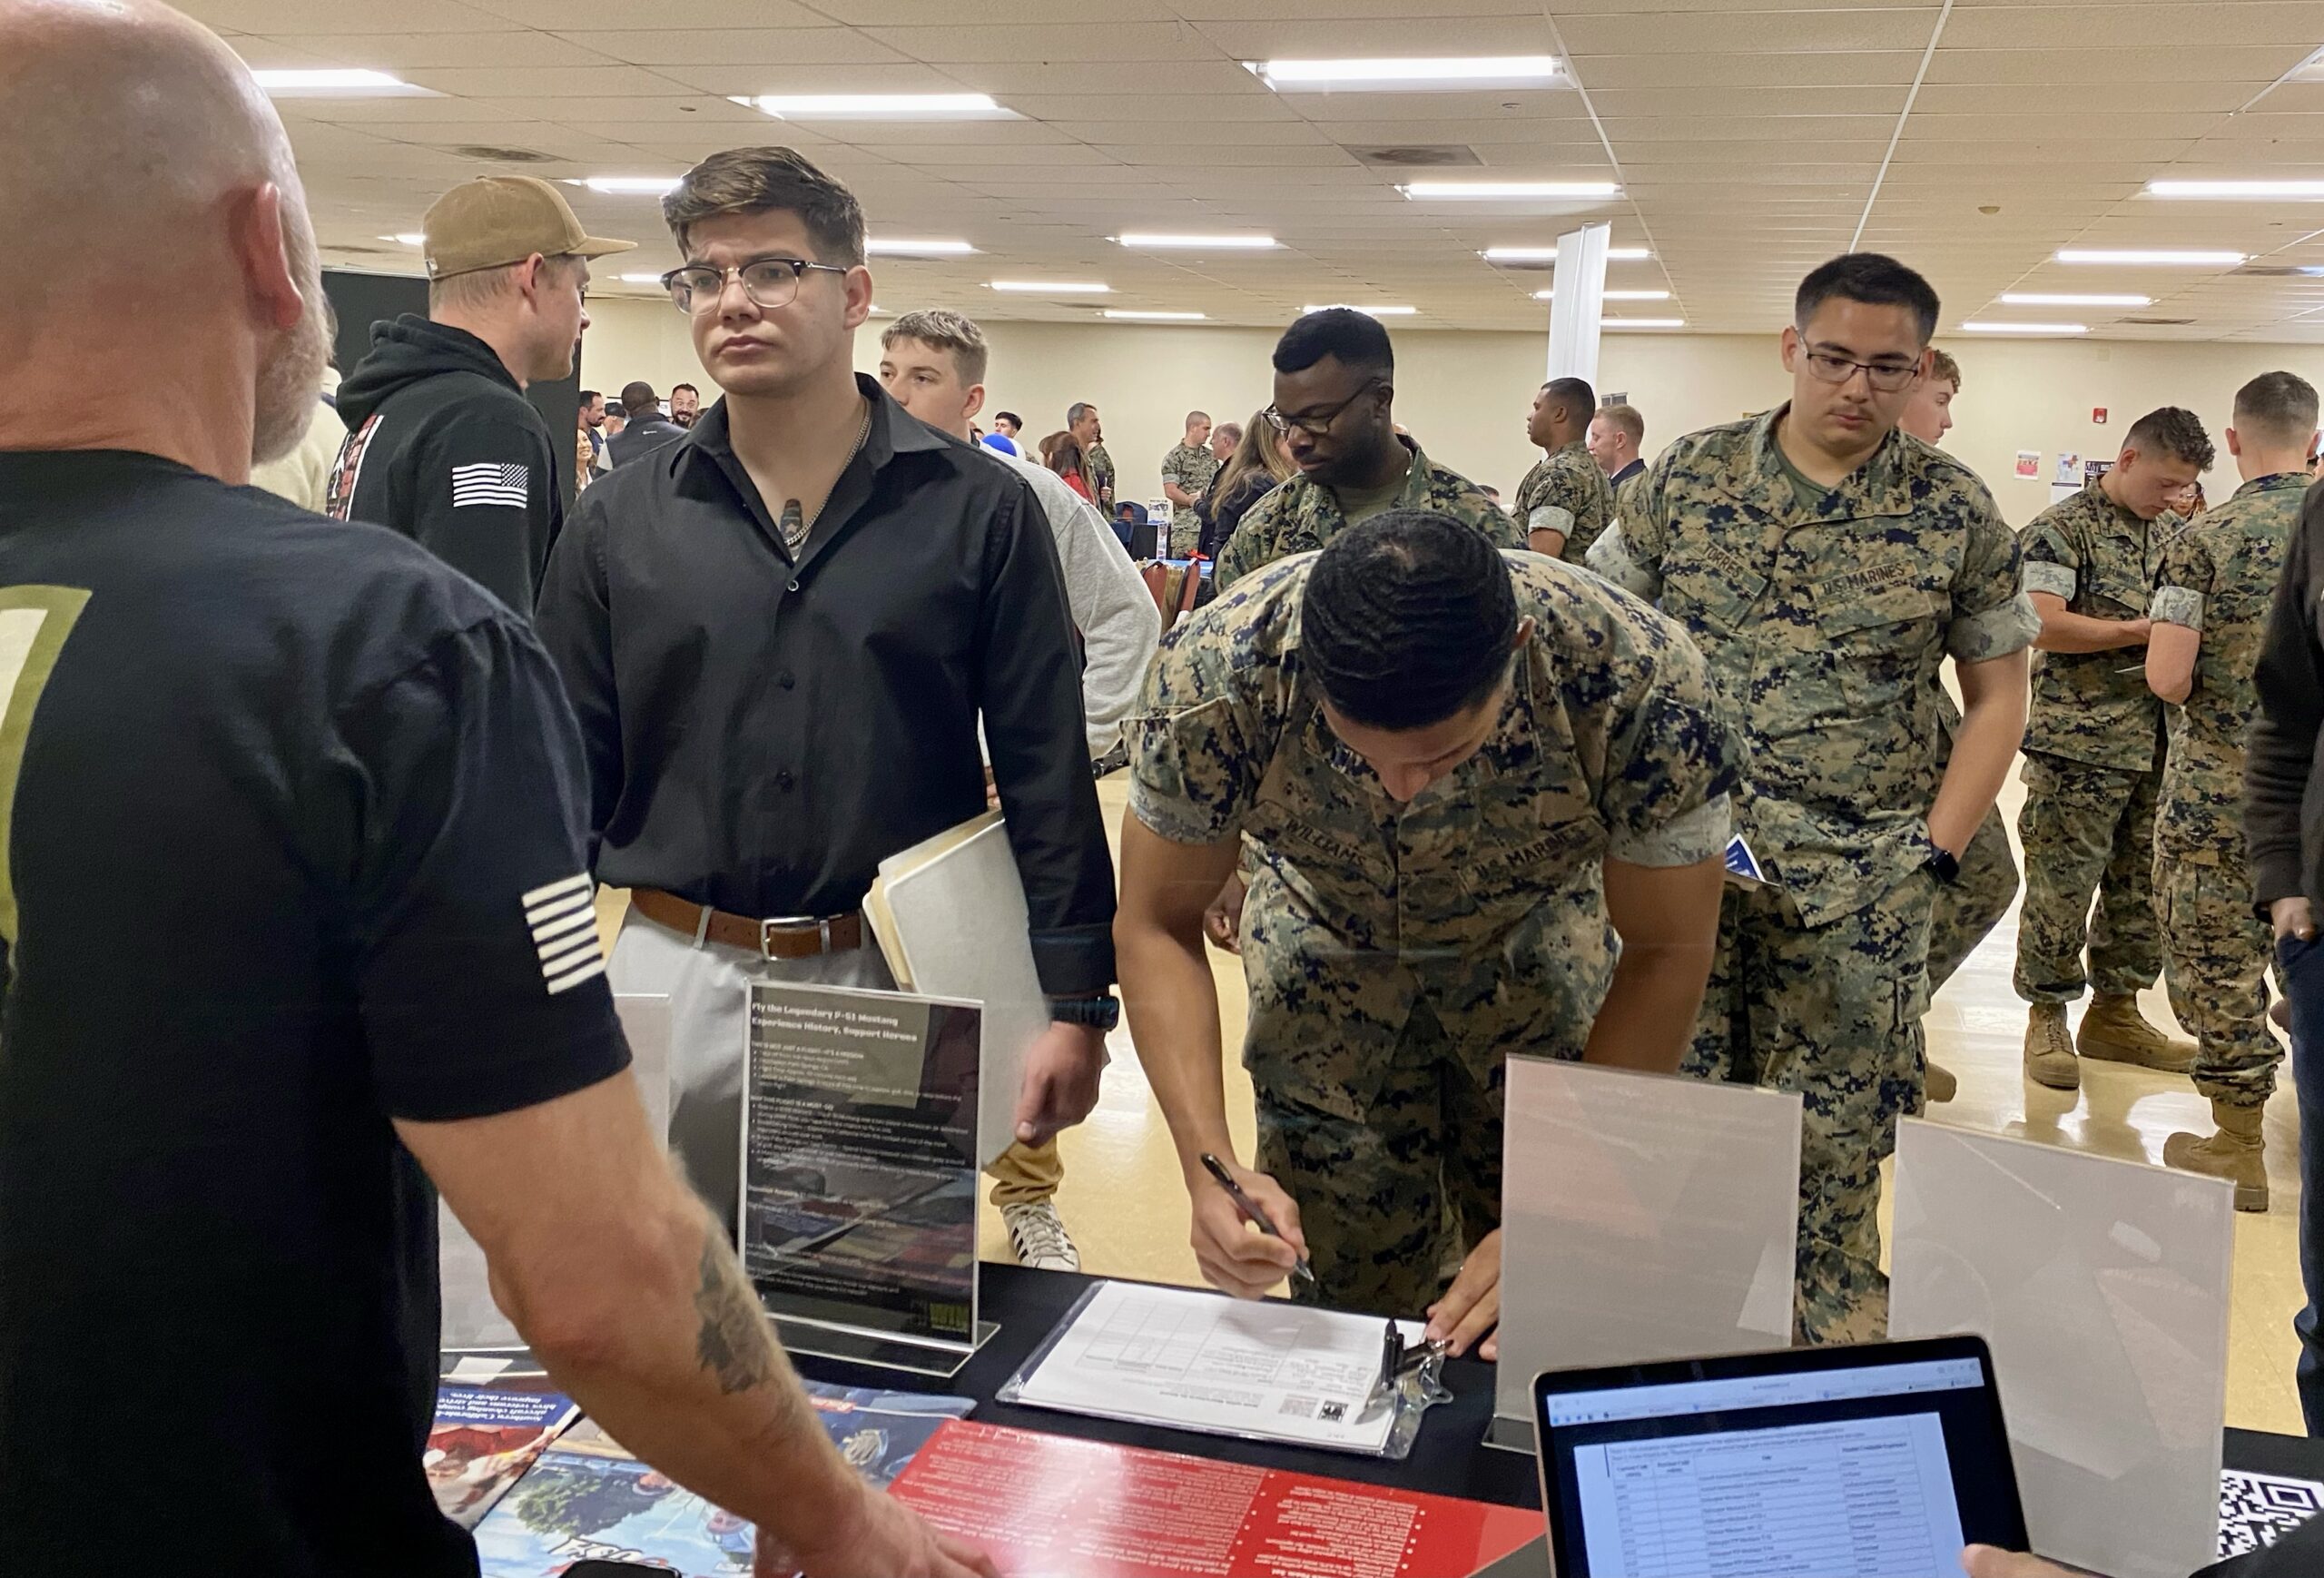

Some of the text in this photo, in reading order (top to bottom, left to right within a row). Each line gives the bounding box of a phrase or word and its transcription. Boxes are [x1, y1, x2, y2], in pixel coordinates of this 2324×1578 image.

[1704, 545, 1743, 578] TORRES
[1847, 562, 1905, 590] MARINES
[1285, 818, 1366, 863] WILLIAMS
[767, 1003, 783, 1013] the
[783, 1005, 832, 1020] Legendary
[834, 1011, 857, 1021] P-51
[858, 1014, 898, 1027] Mustang
[752, 1017, 918, 1042] Experience History, Support Heroes
[497, 1414, 543, 1422] Southern
